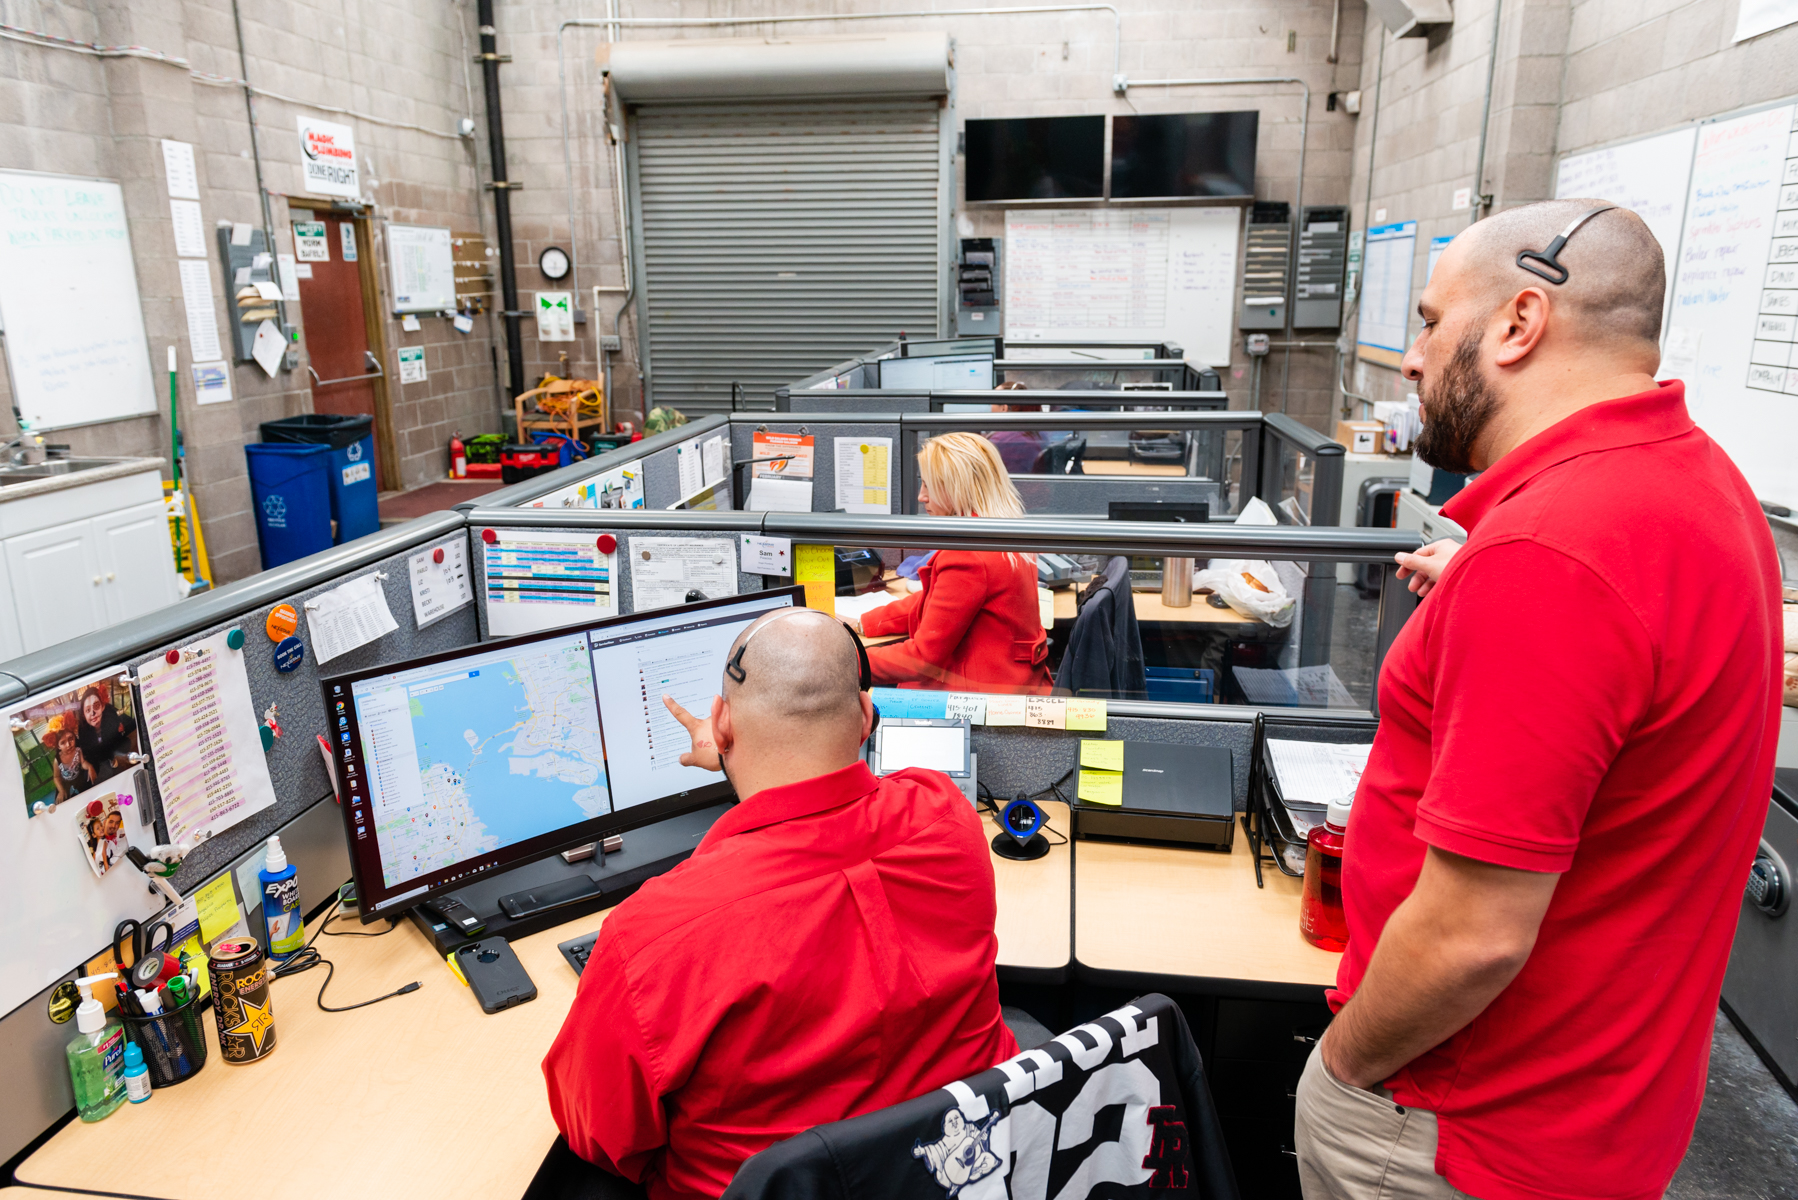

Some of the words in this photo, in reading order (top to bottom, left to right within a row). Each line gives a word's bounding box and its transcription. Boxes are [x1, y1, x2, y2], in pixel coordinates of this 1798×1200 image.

[327, 166, 355, 185] RIGHT
[417, 566, 428, 575] PABLO
[421, 598, 432, 607] BECKY
[424, 604, 445, 617] WAREHOUSE
[277, 651, 287, 660] BOOK
[266, 875, 298, 898] EXPO
[210, 972, 222, 1012] ENERGY
[216, 1015, 227, 1046] DRNK
[104, 1044, 123, 1066] Purell
